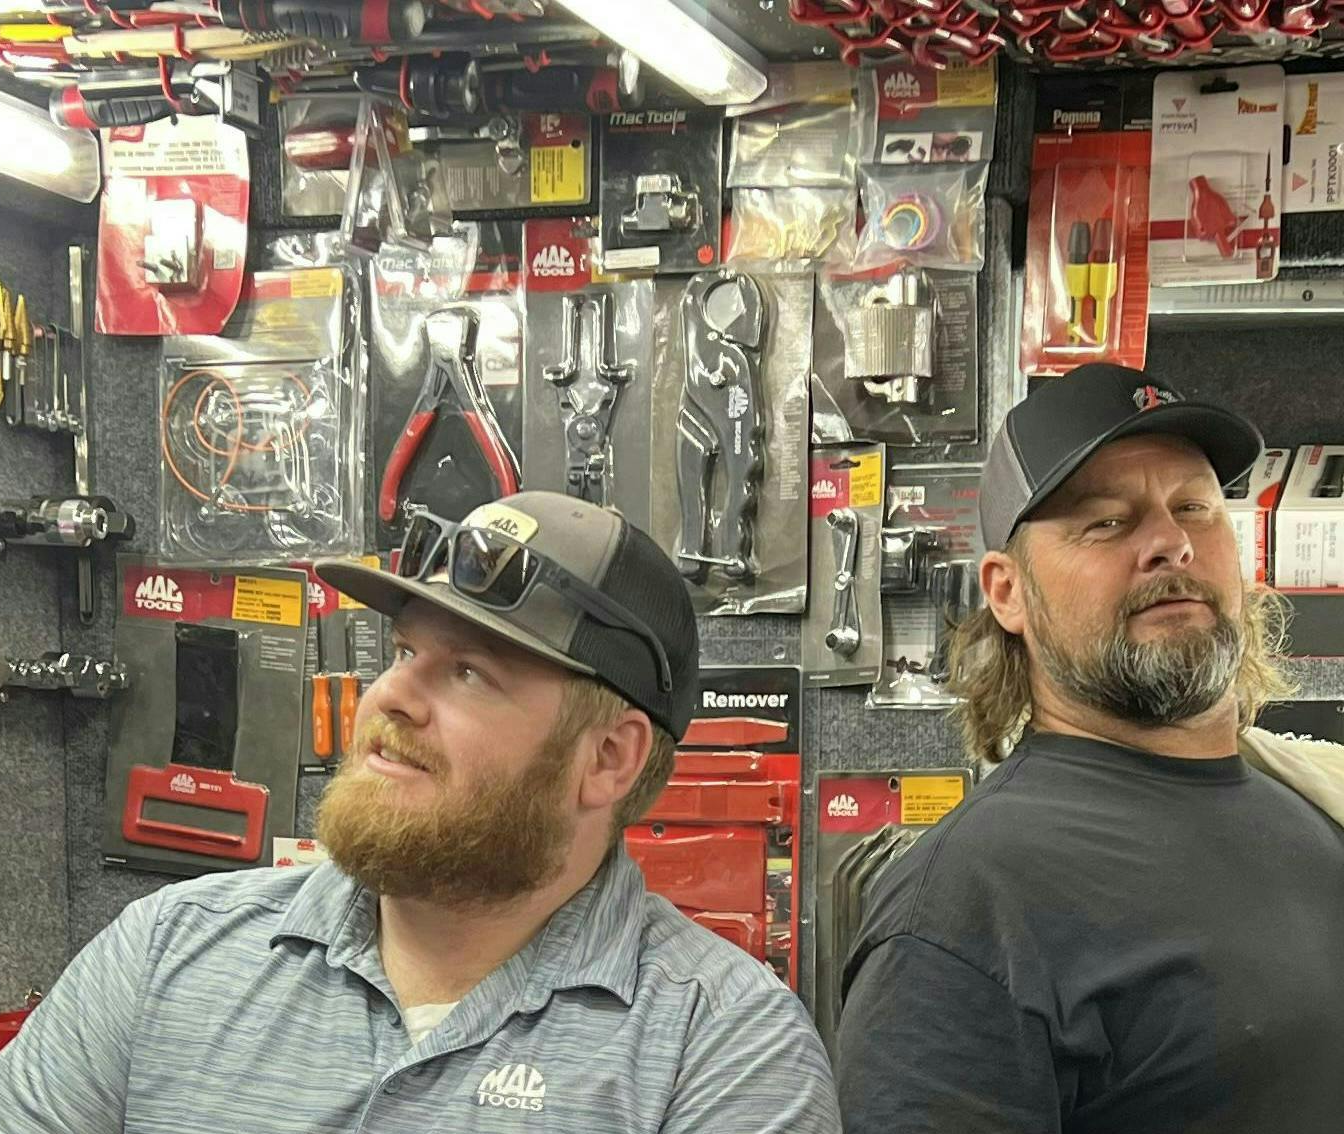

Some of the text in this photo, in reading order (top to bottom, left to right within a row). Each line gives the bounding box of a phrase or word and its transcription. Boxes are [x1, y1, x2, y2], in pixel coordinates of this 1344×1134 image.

[884, 71, 920, 90] MAC
[610, 109, 687, 124] Mac Tools
[1053, 109, 1101, 125] Pomona
[379, 256, 413, 270] Mac
[533, 246, 575, 268] MAC
[533, 266, 575, 277] TOOLS
[735, 387, 749, 418] MAC
[811, 479, 836, 494] MAC
[135, 574, 183, 603] MAC
[135, 599, 183, 613] TOOLS
[702, 690, 789, 709] Remover
[171, 773, 197, 787] MAC
[827, 794, 859, 811] MAC
[827, 808, 859, 817] TOOLS
[476, 1063, 547, 1098] MAC
[476, 1092, 544, 1112] TOOLS
